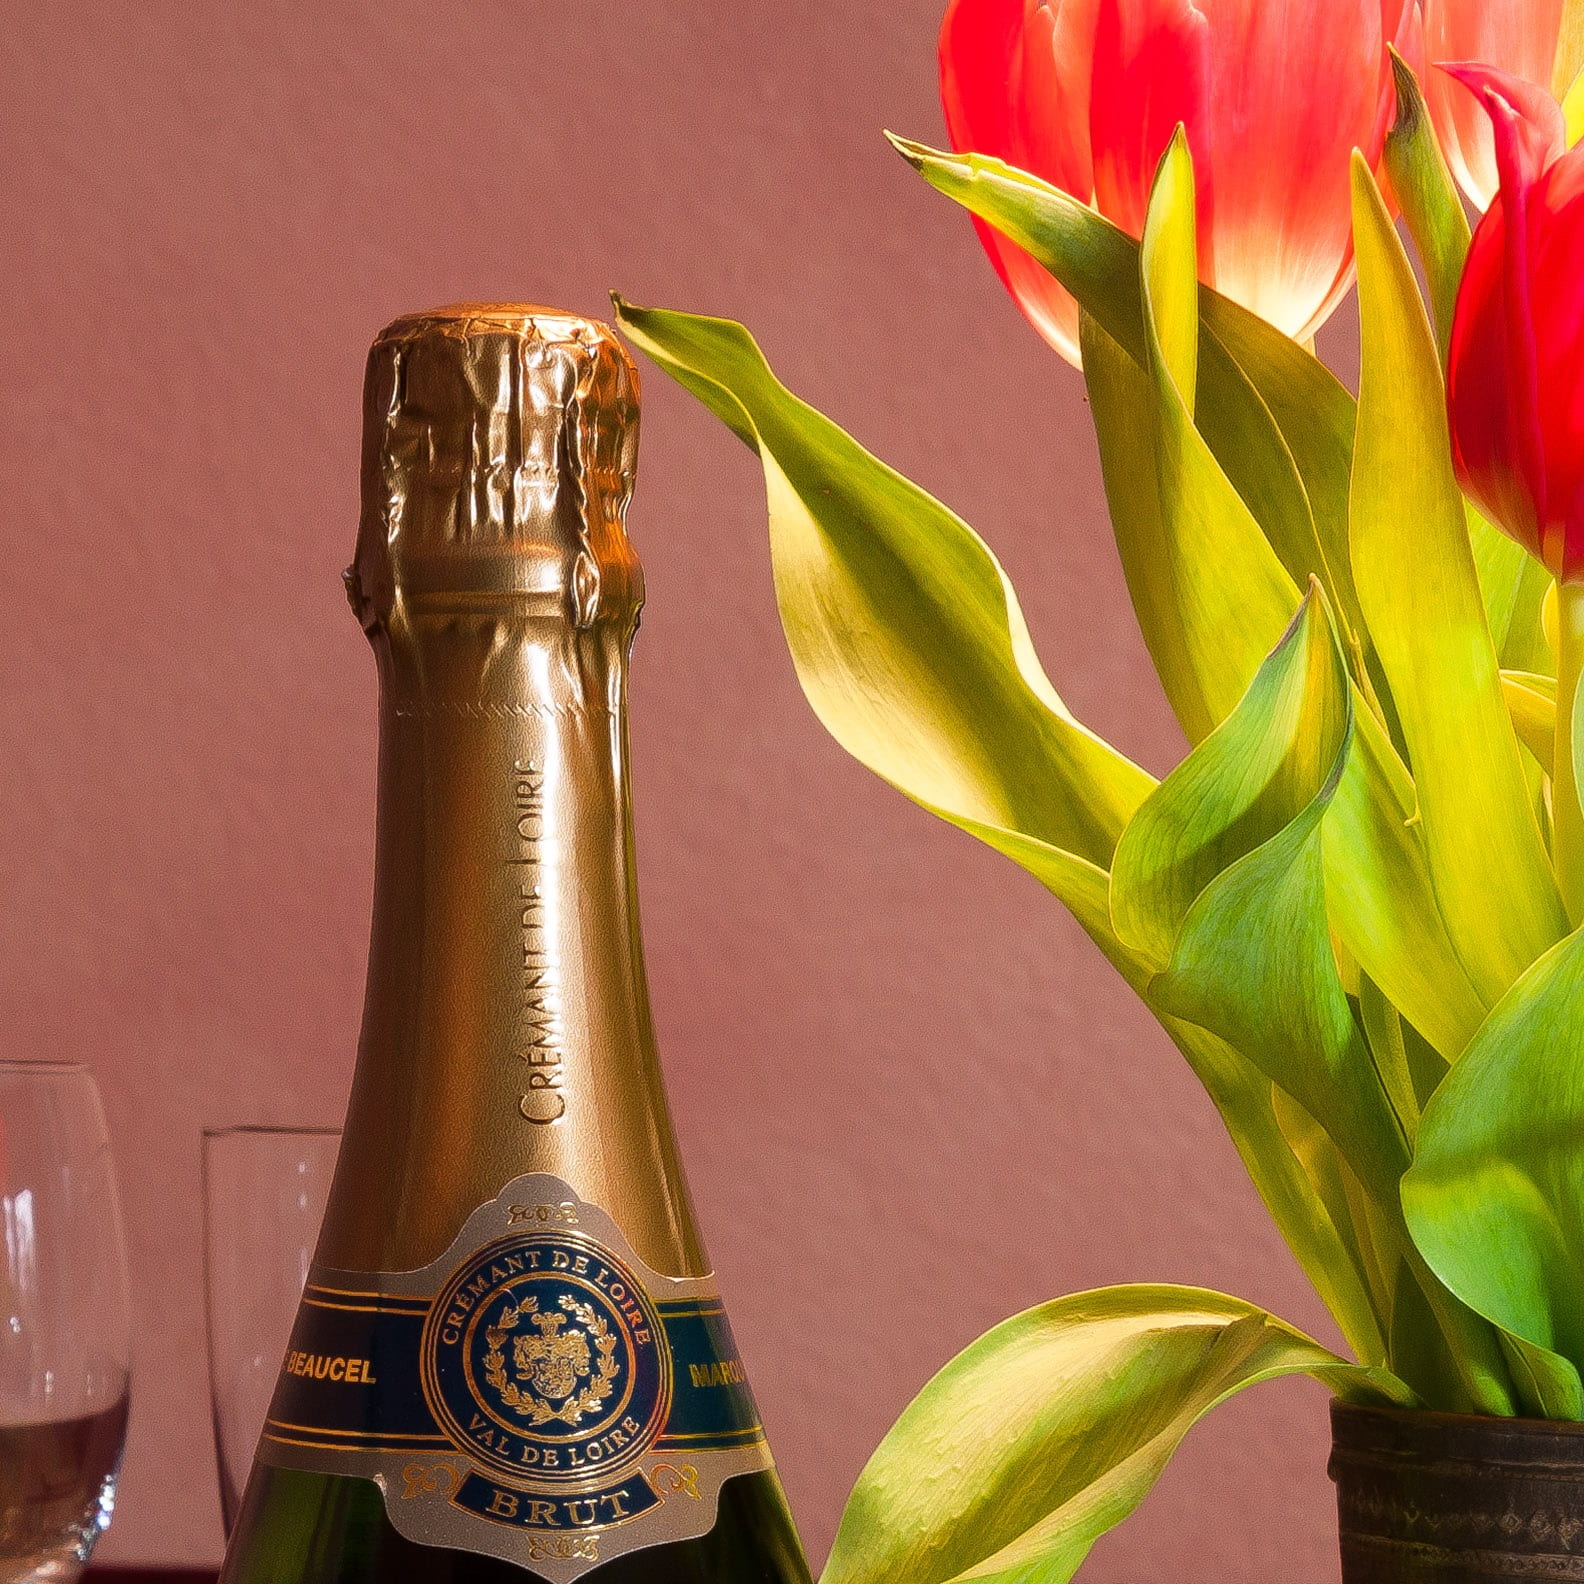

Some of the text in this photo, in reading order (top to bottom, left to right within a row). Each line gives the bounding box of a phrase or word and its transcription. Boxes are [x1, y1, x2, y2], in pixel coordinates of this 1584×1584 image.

[442, 1250, 652, 1345] CRÉMANT DE LOIRE
[287, 1351, 377, 1384] BEAUCEL
[468, 1413, 641, 1467] VAL DE LOIRE
[485, 1489, 630, 1526] BRUT
